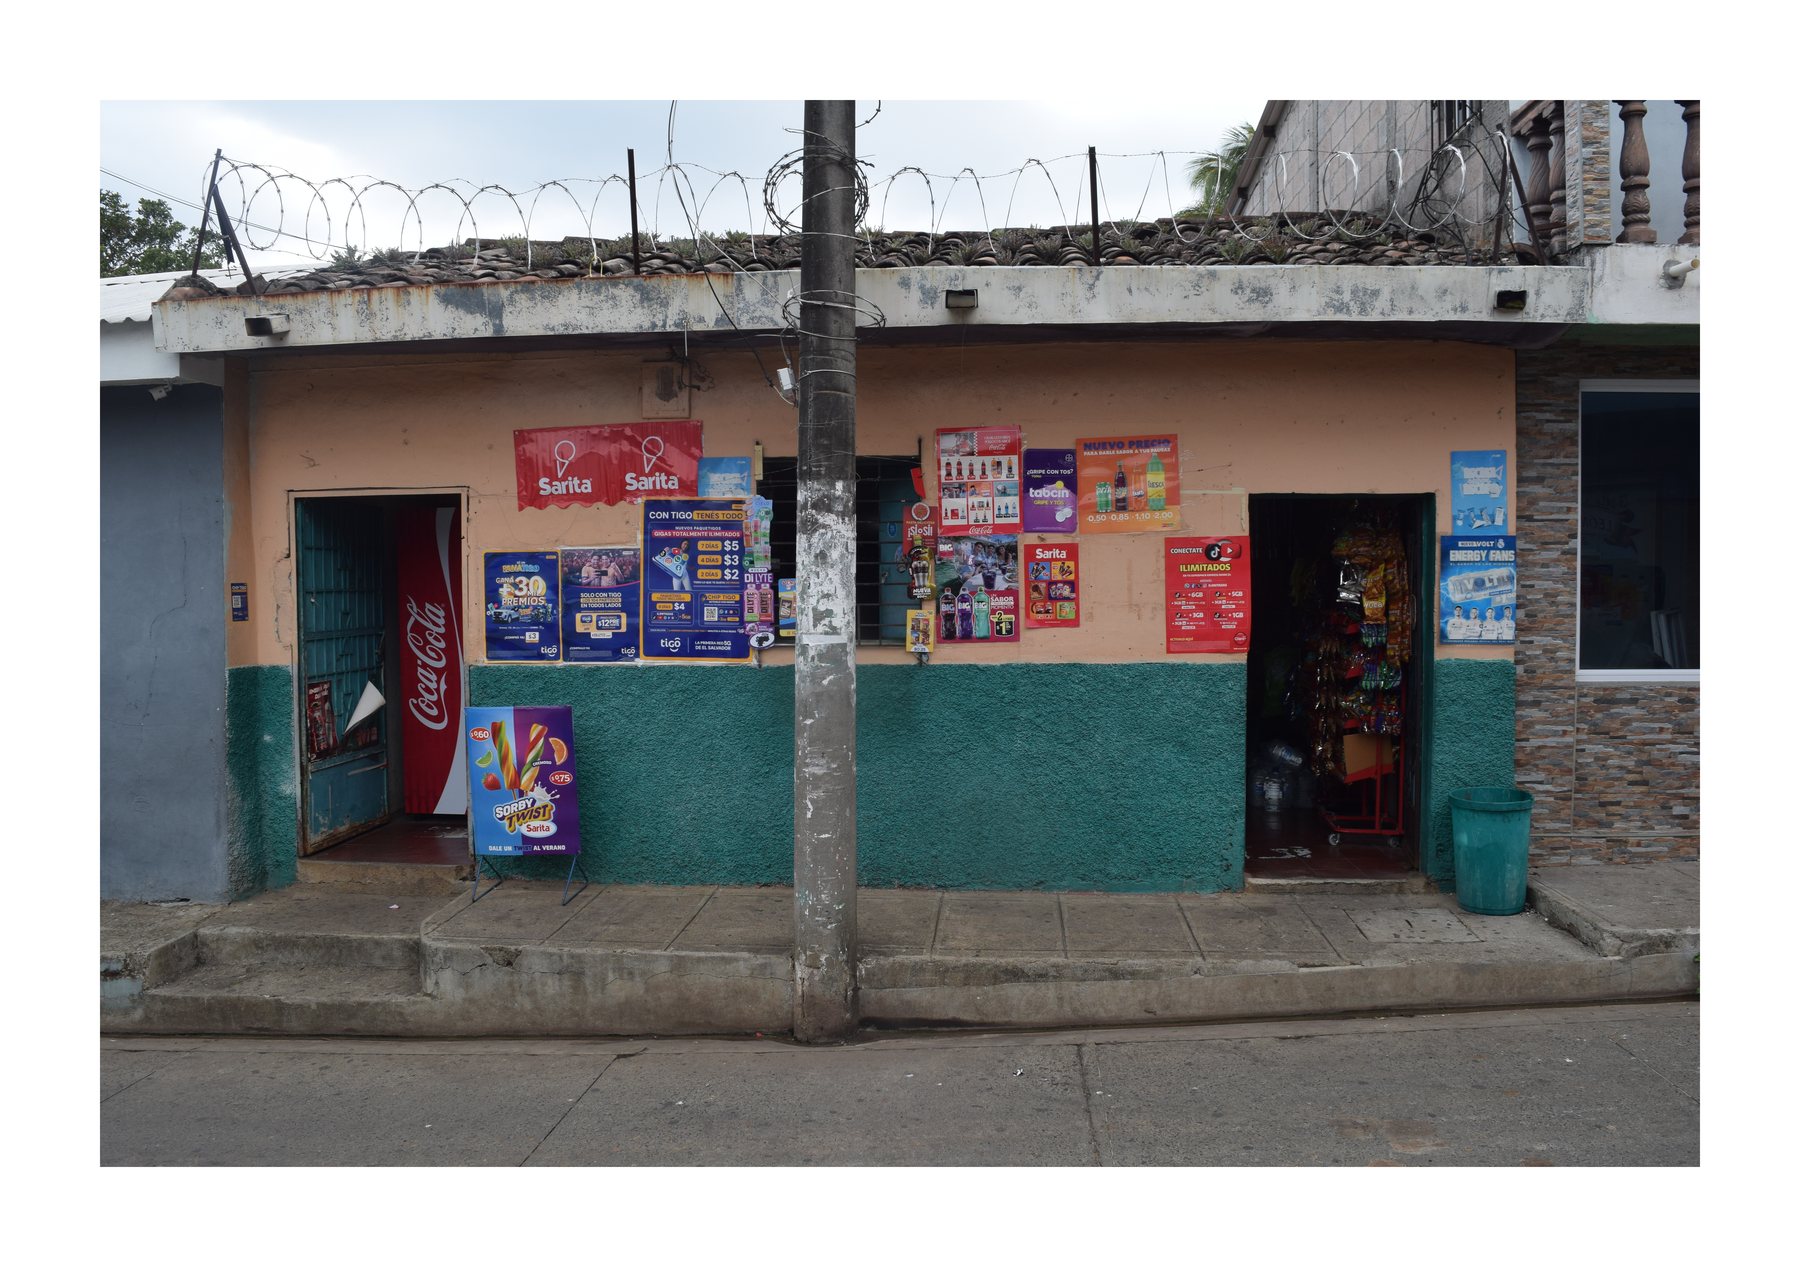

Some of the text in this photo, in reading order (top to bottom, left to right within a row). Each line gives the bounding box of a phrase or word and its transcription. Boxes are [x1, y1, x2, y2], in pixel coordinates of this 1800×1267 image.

[1084, 439, 1171, 450] NUEVO PRECIO
[539, 476, 592, 495] Sarita
[625, 472, 679, 491] Sarita
[1029, 488, 1069, 498] tabcin
[969, 526, 993, 534] Coca-Cola
[724, 540, 739, 552] $5
[1036, 549, 1066, 559] Sarita
[1450, 550, 1515, 561] ENERGY FANS
[724, 554, 739, 566] $3
[1180, 564, 1231, 572] ILIMITADOS
[724, 568, 739, 580] $2
[674, 602, 685, 610] $4
[998, 612, 1002, 620] 2
[406, 595, 448, 730] Coca-Cola
[496, 798, 533, 818] SORBY
[507, 804, 549, 830] TWIST
[526, 824, 550, 832] Sarita
